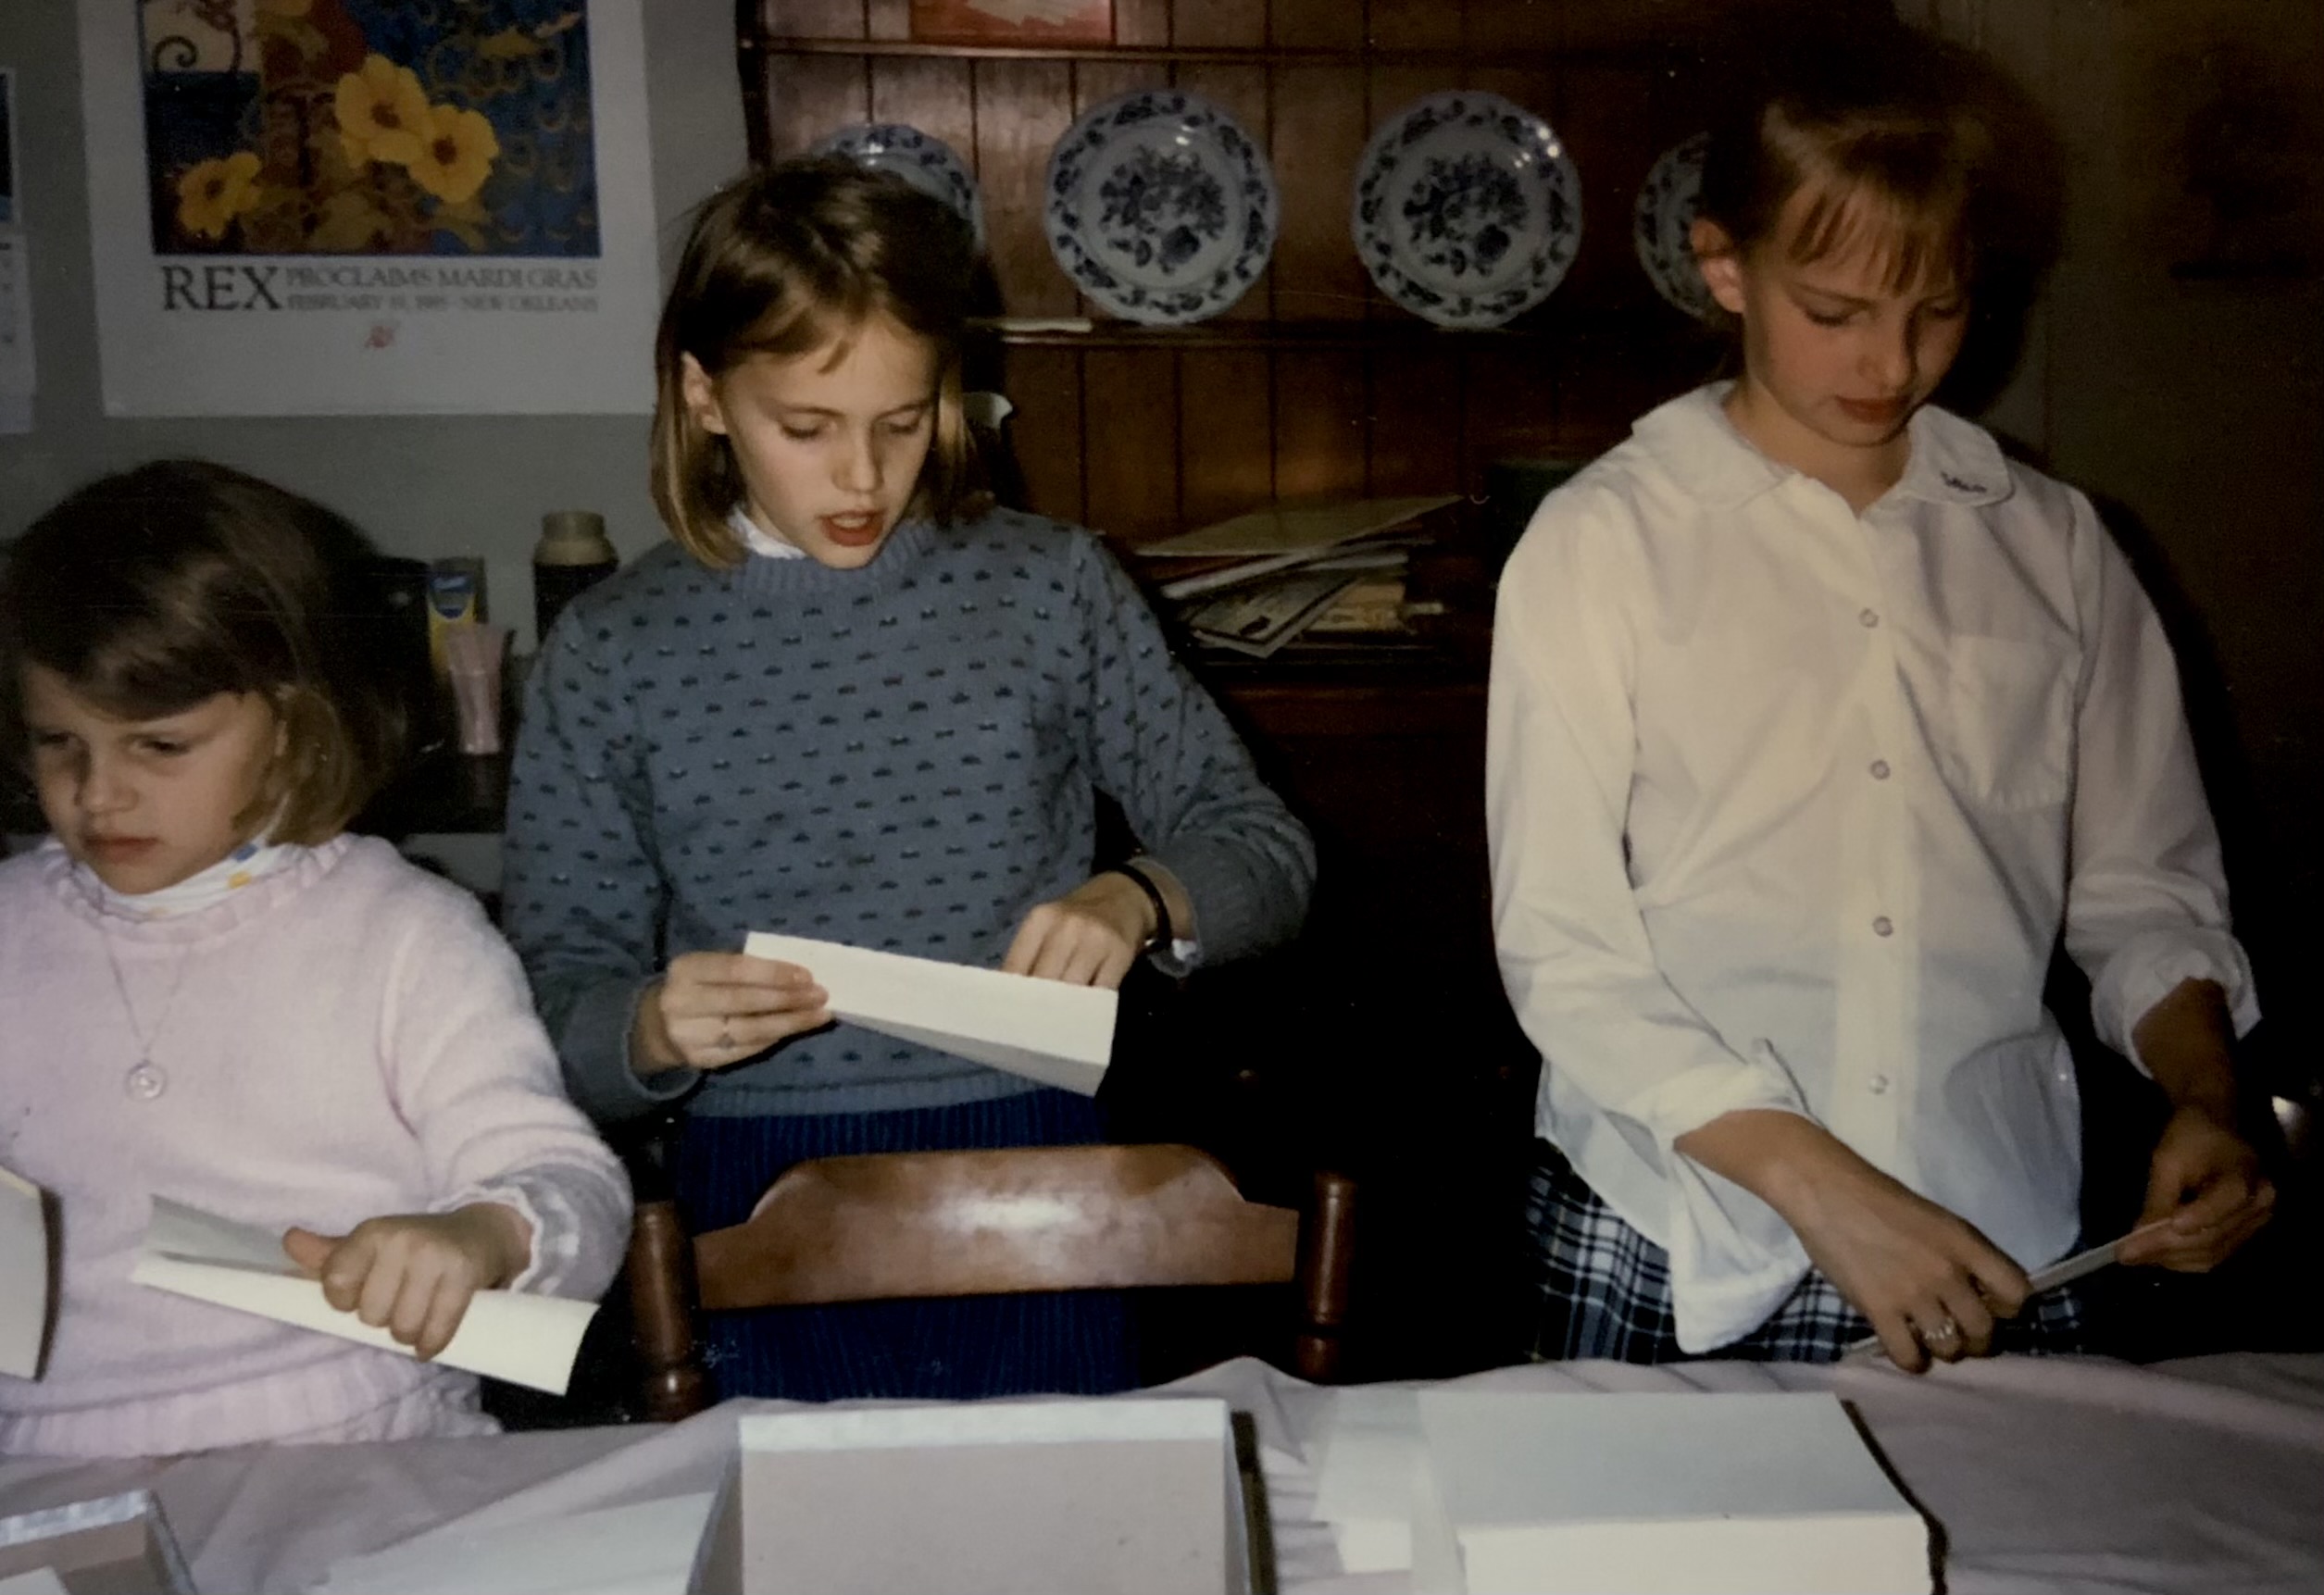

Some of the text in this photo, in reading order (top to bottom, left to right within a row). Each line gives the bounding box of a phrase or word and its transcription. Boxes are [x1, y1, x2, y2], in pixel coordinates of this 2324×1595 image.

[161, 265, 598, 311] REX PROCLAIMS MARDI GRAS
